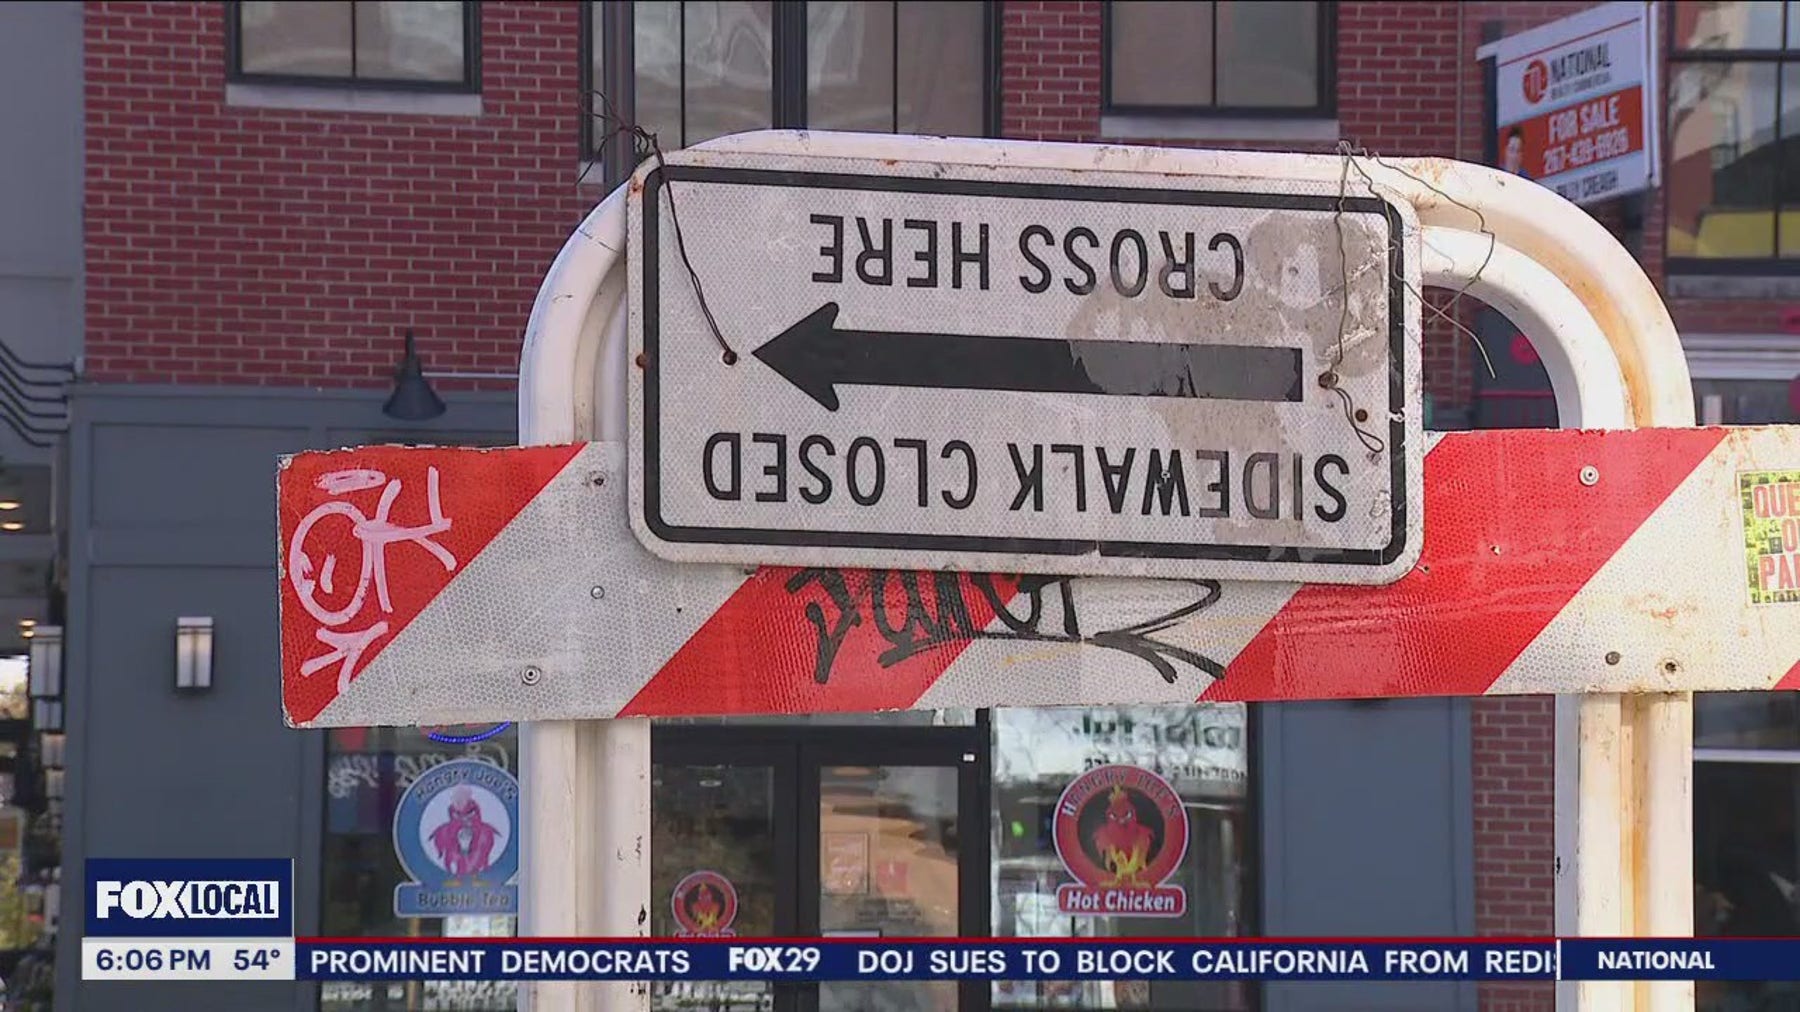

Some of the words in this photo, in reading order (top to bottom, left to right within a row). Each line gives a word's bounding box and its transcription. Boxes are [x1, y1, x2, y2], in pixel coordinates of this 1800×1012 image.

[1552, 42, 1612, 83] NATIONAL
[1549, 109, 1578, 145] FOR
[1580, 95, 1620, 134] SALE
[809, 214, 991, 290] HERE
[1018, 224, 1246, 302] CROSS
[702, 431, 978, 511] CLOSED
[1007, 441, 1349, 523] SIDEWALK
[1782, 518, 1800, 552] O
[418, 892, 475, 909] Bubble
[482, 892, 510, 908] Tea
[1066, 890, 1101, 910] Hot
[1104, 888, 1176, 912] Chicken
